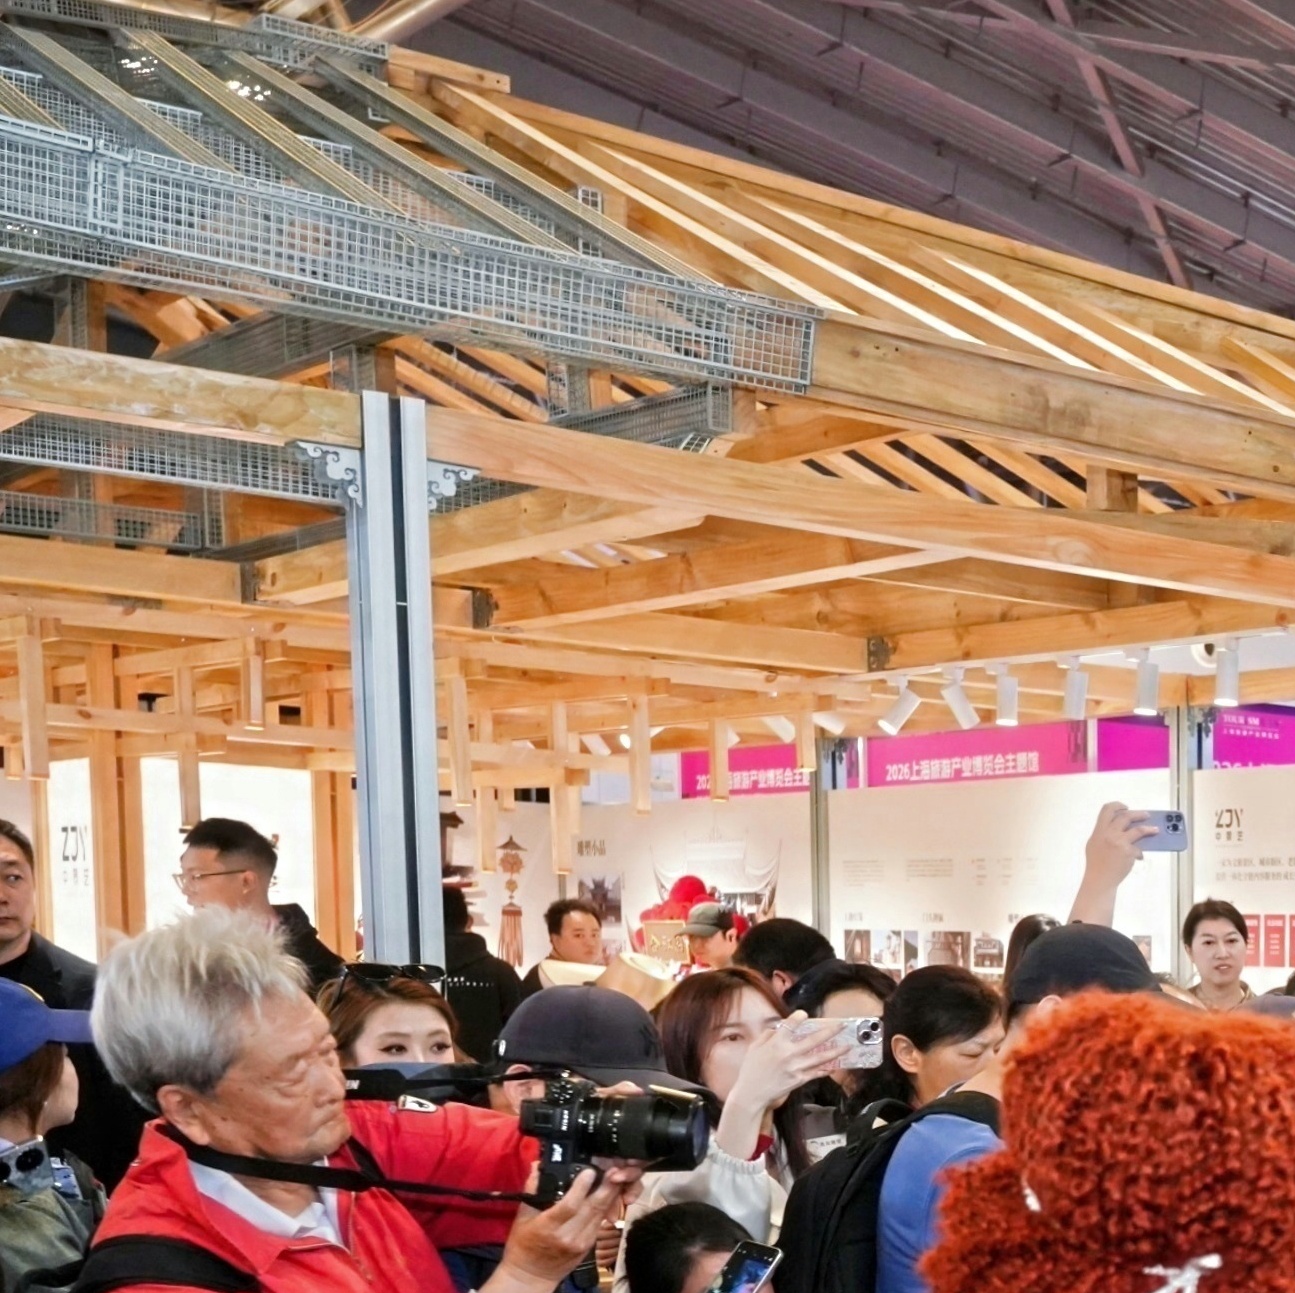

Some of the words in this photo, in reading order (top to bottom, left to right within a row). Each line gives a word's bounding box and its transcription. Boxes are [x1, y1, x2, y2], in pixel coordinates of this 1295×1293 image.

[886, 752, 1040, 783] 2026上海旅游产业博览会主题馆
